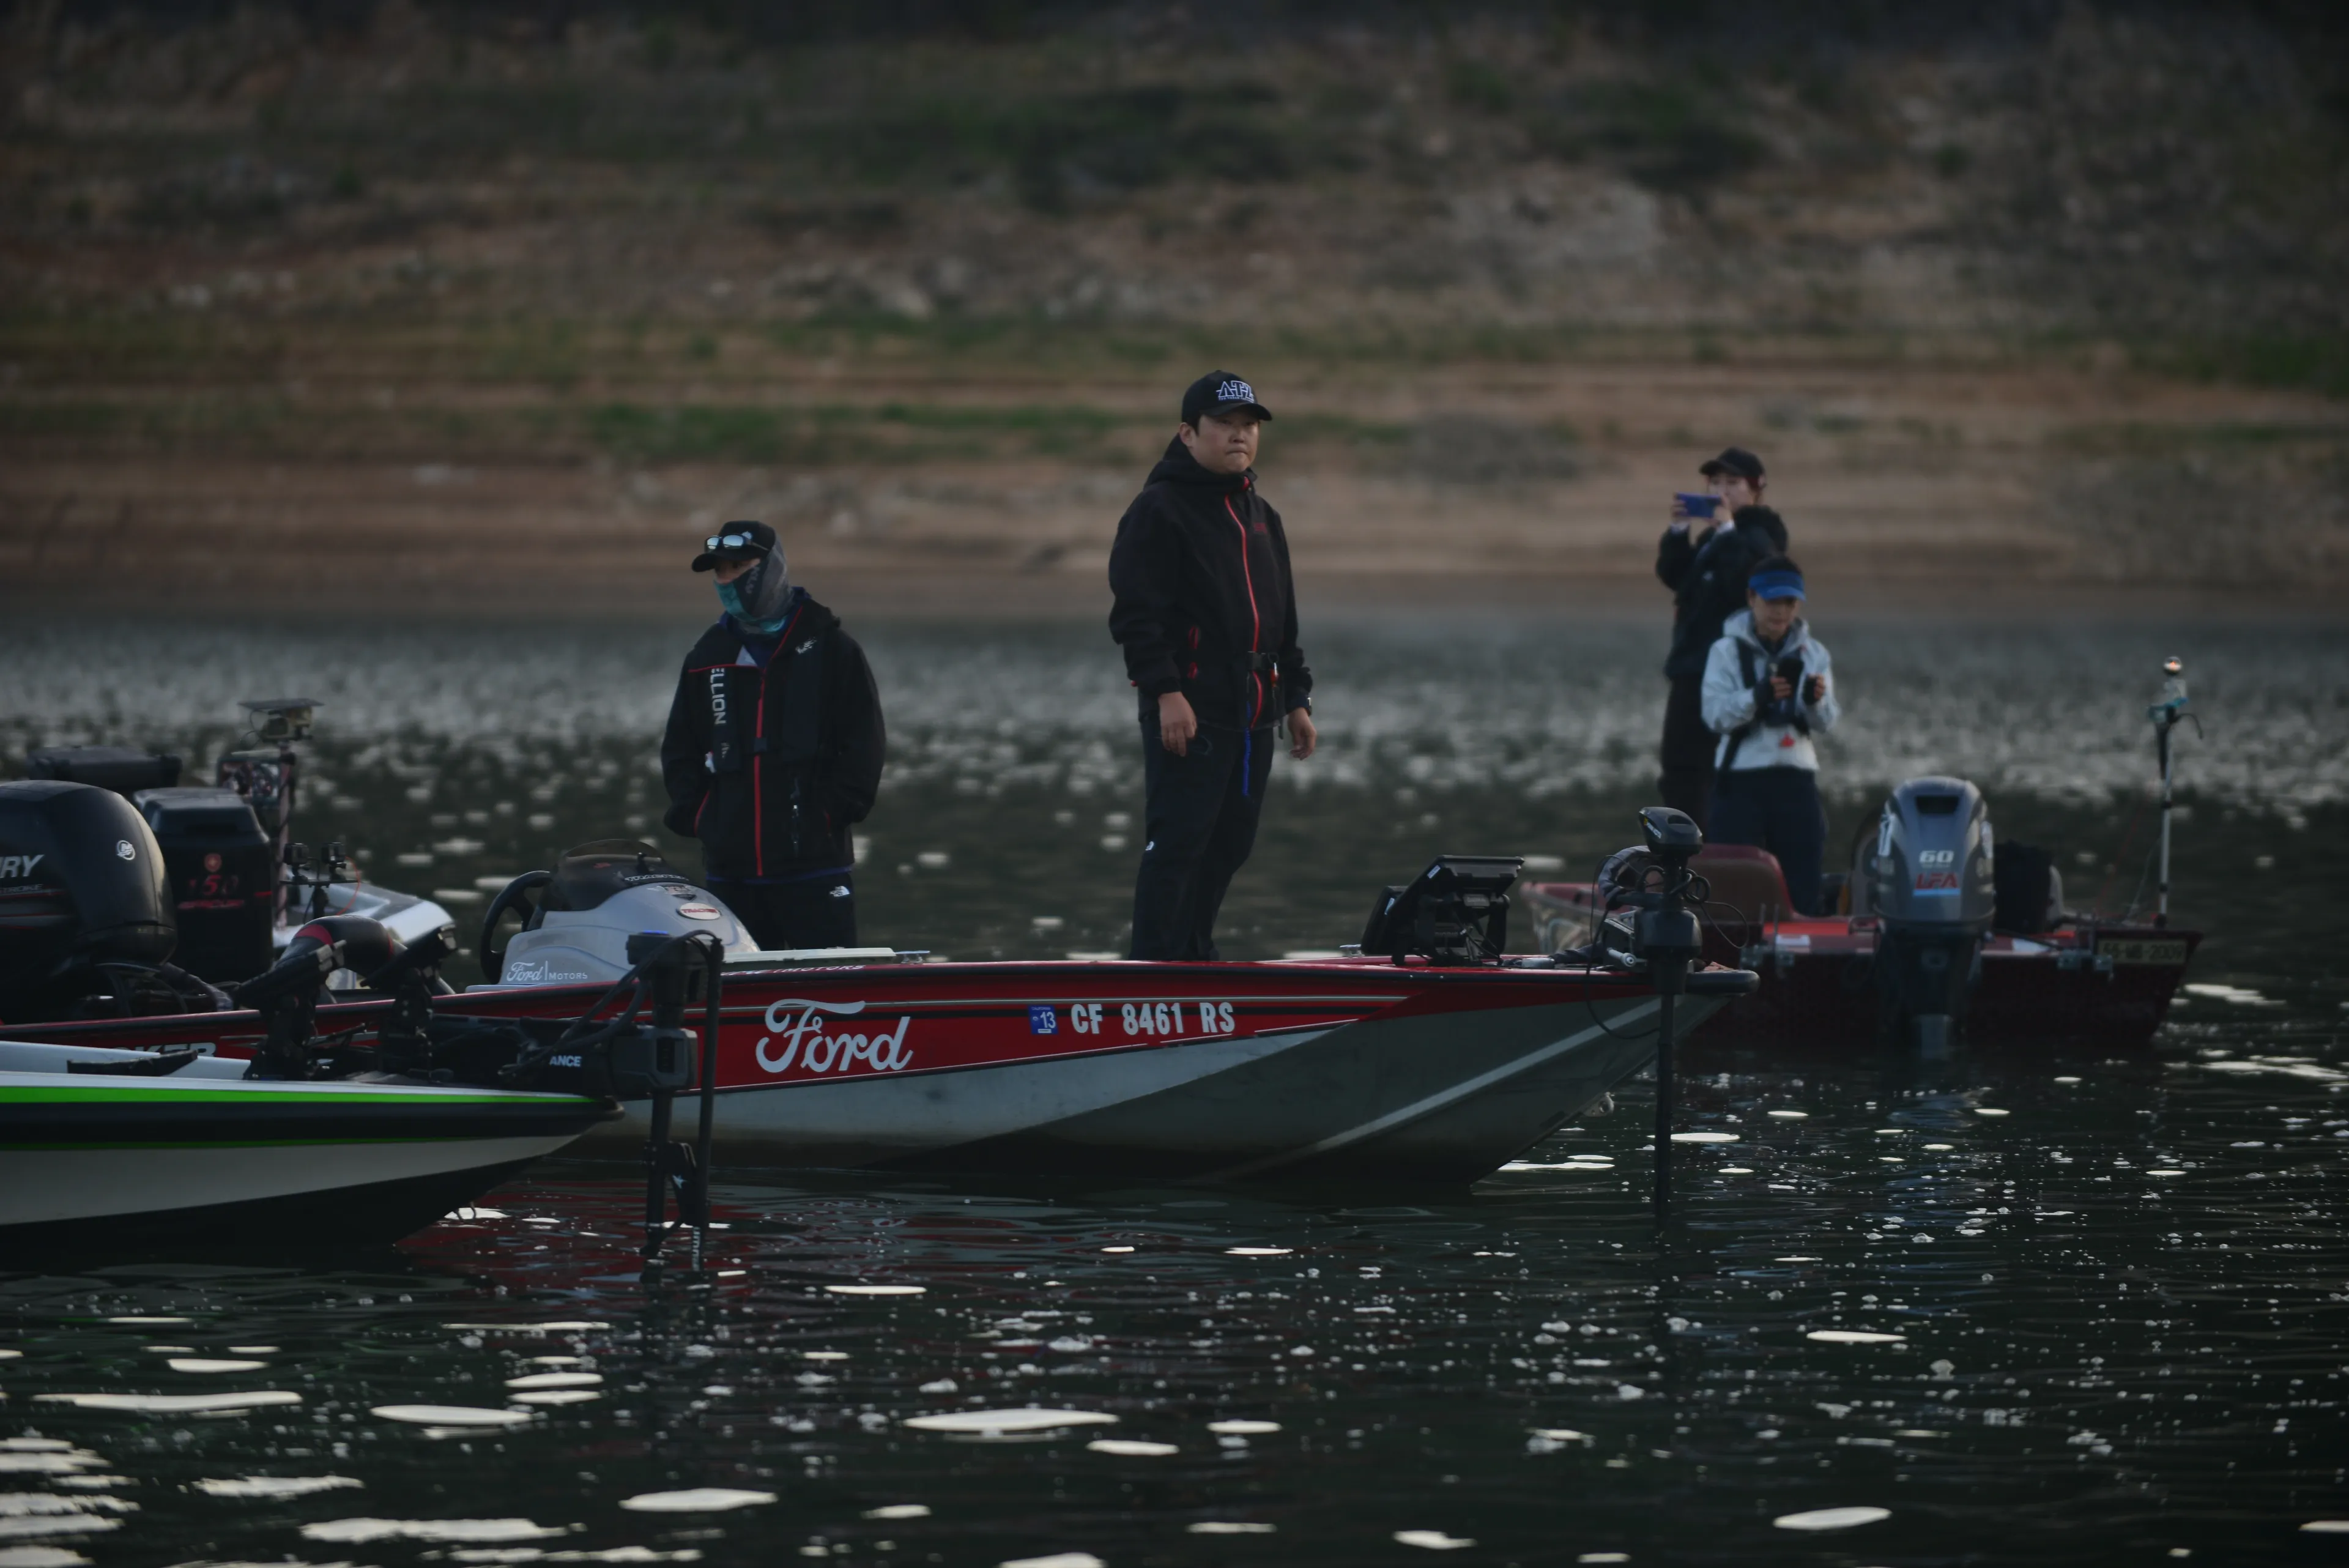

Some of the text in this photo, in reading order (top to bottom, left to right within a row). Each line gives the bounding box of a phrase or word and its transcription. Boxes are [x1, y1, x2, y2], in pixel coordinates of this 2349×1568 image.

[0, 854, 45, 879] RY
[1919, 850, 1954, 863] 60
[507, 962, 543, 981] Ford
[1040, 1011, 1056, 1028] 13
[1071, 1002, 1235, 1035] CF 8461 RS
[755, 998, 913, 1073] Ford
